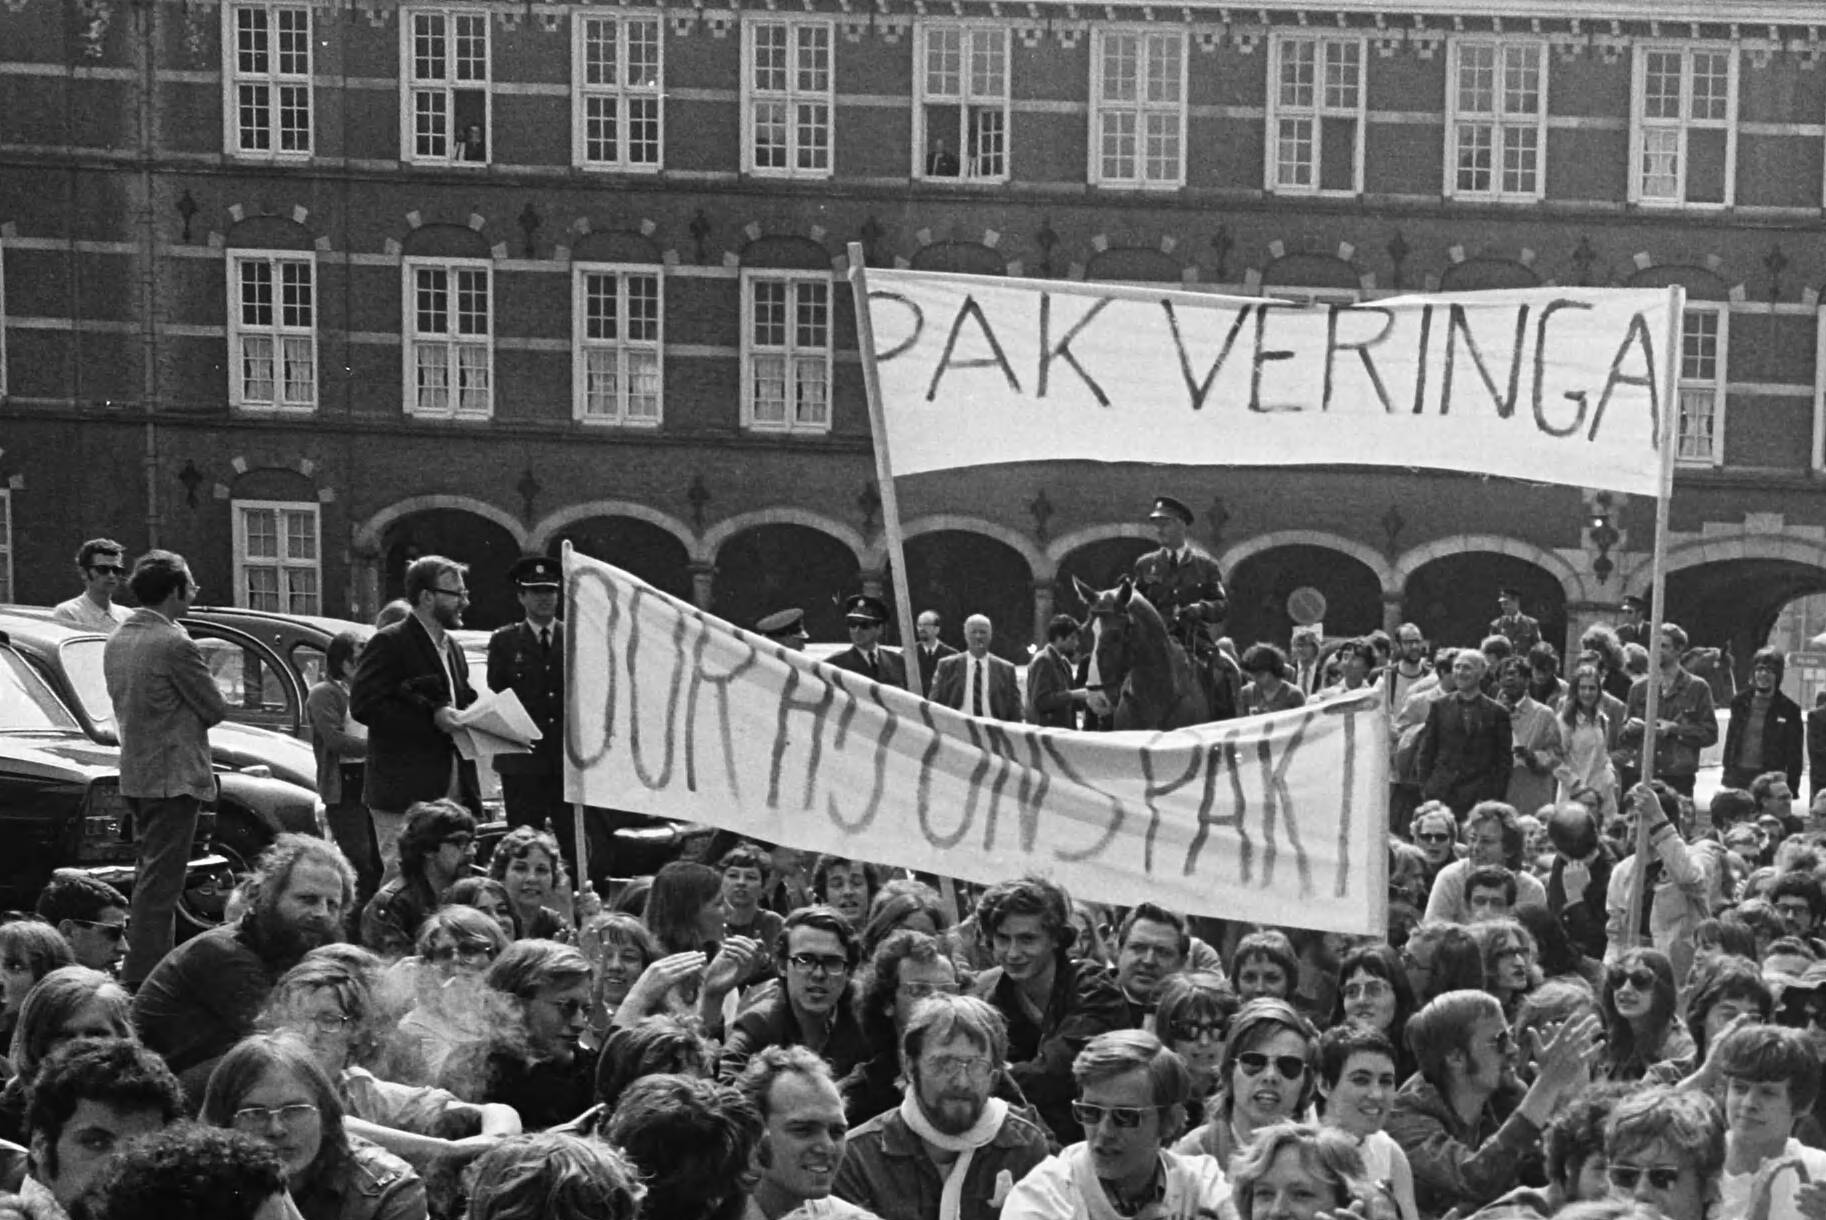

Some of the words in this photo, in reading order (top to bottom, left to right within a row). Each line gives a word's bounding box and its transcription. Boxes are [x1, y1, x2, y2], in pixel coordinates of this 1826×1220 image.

[867, 290, 1116, 407] PAK
[1160, 298, 1661, 450] VERINGA
[1141, 698, 1384, 898] PAKT
